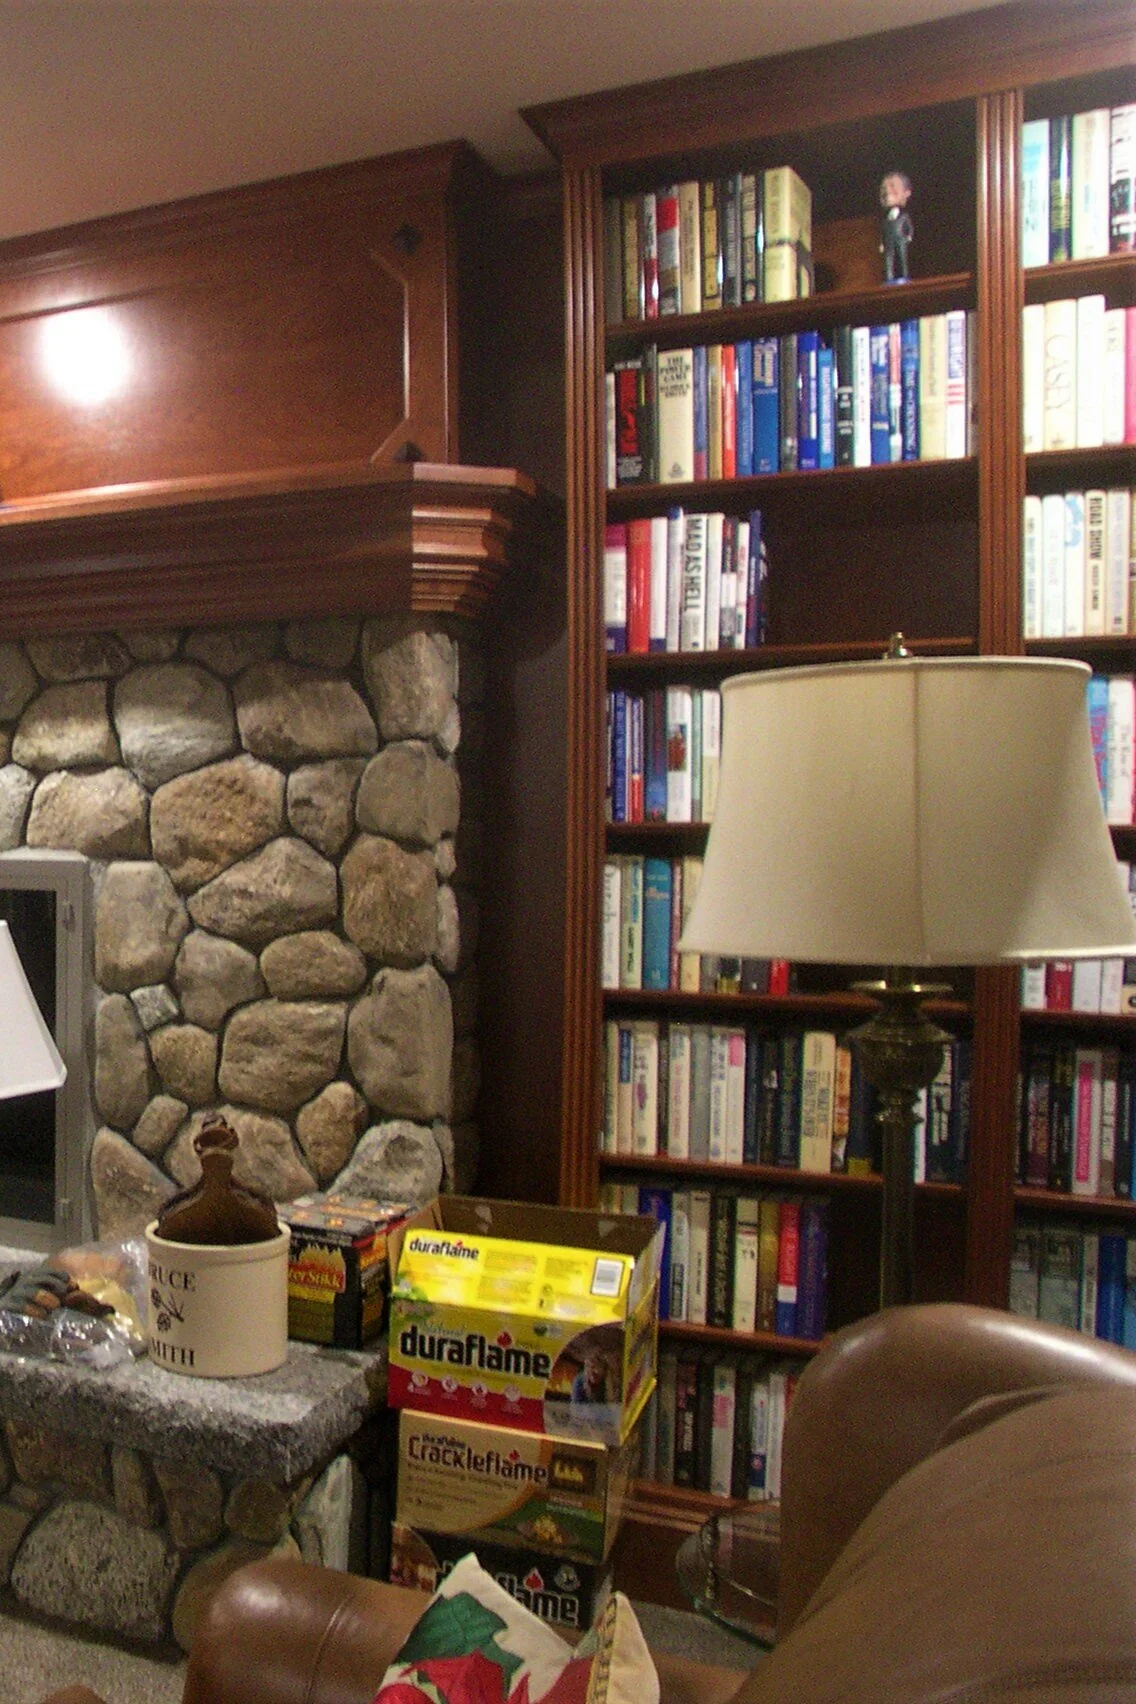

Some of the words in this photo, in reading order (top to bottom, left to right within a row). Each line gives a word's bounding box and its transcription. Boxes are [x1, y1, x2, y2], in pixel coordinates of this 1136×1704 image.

[686, 518, 703, 552] MAD
[685, 555, 702, 573] AS
[684, 575, 701, 612] HELL
[409, 1238, 479, 1260] duraflame
[149, 1262, 196, 1292] RUCE
[151, 1338, 195, 1367] MITH
[400, 1325, 551, 1378] duraflame
[408, 1436, 548, 1483] Crackleflame
